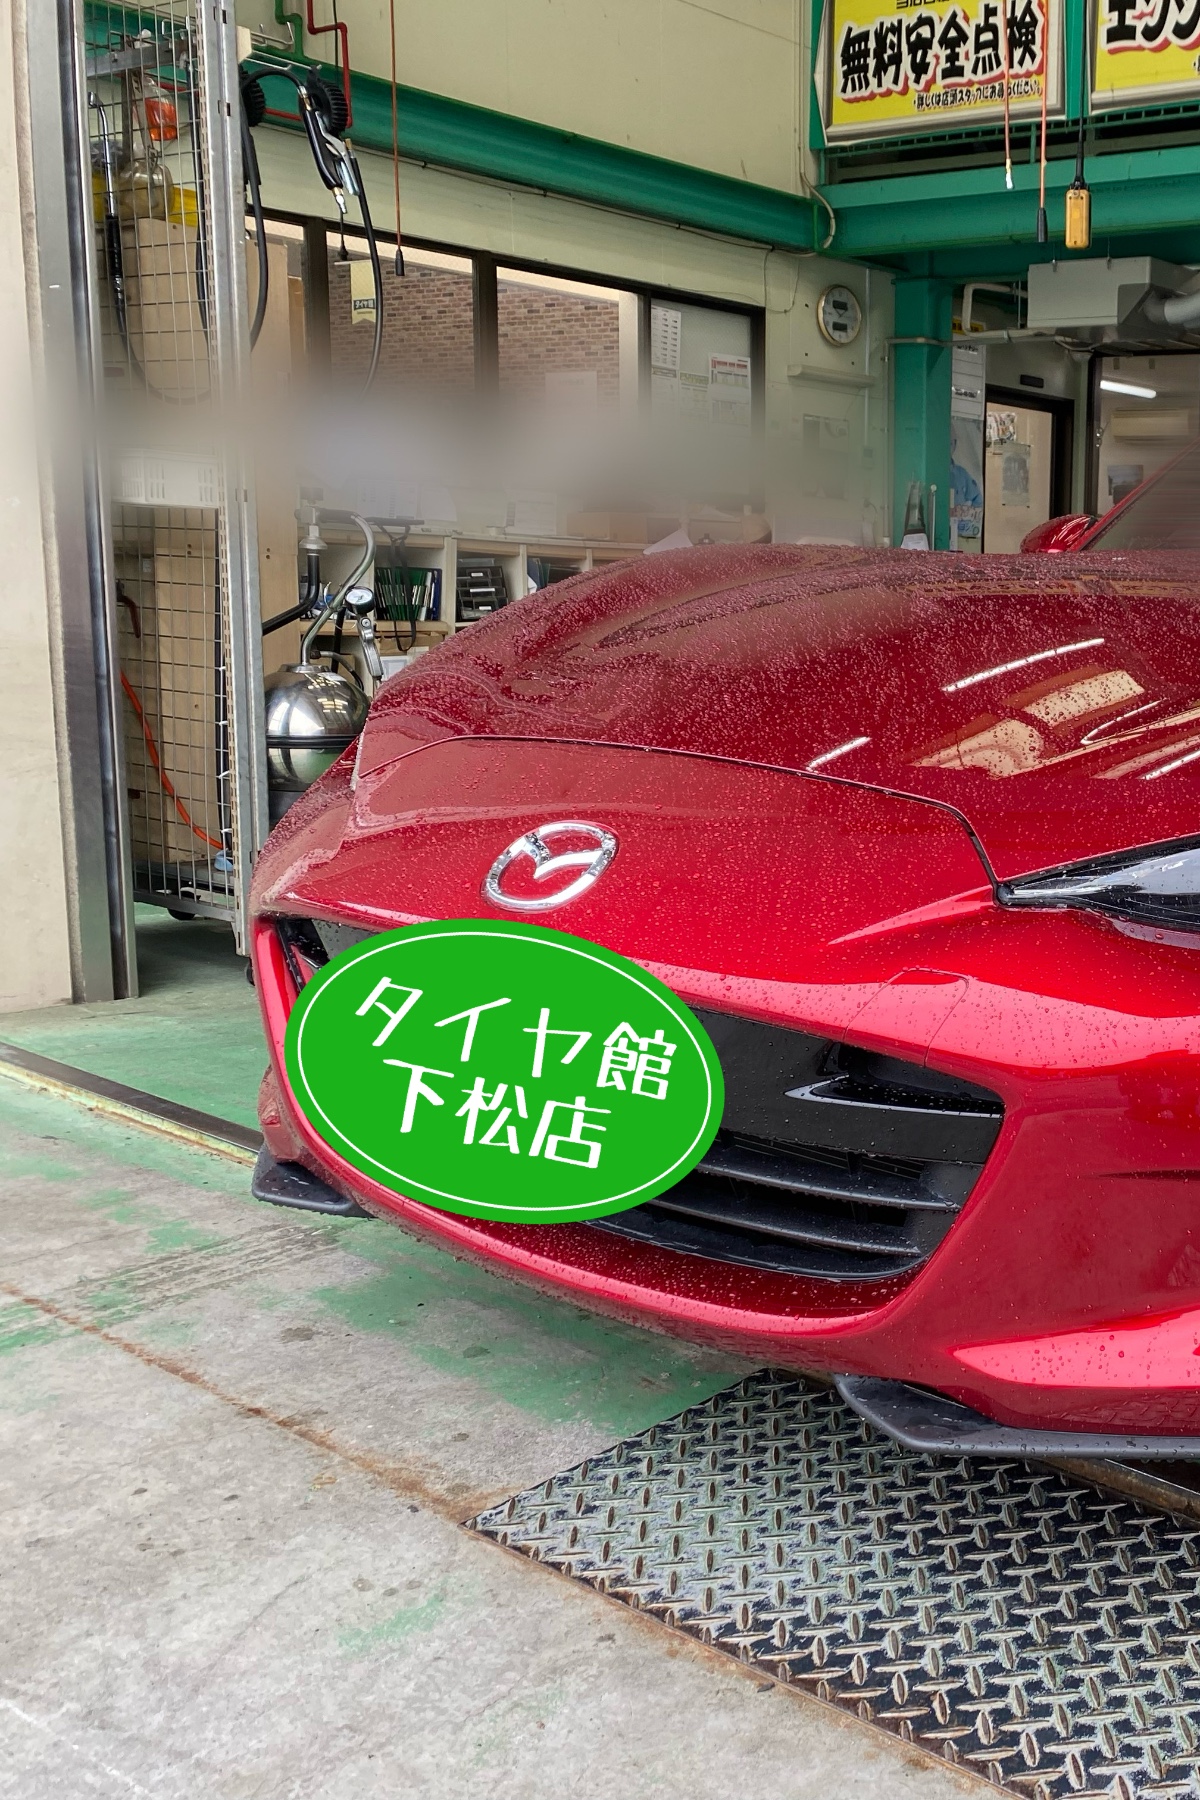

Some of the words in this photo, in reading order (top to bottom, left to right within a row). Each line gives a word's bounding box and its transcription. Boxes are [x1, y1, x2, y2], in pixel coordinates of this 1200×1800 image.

[840, 0, 1038, 94] 無料安全点検
